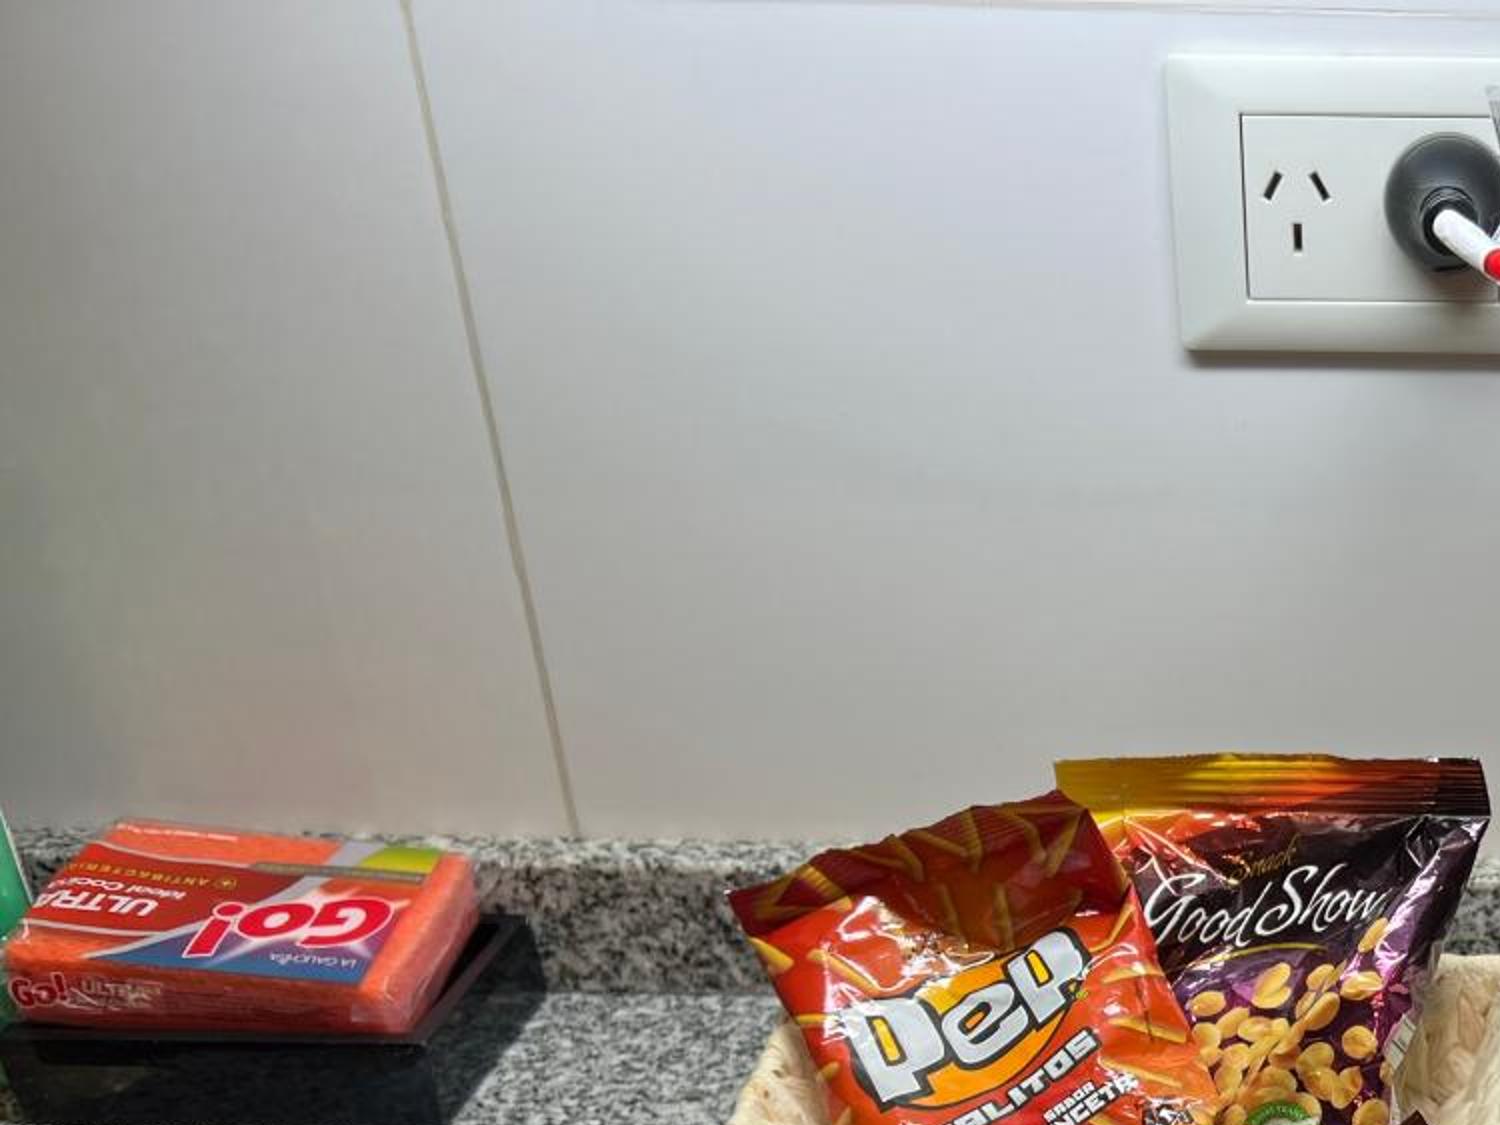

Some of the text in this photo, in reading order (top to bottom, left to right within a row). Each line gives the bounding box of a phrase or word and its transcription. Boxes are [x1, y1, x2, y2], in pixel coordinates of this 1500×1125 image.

[32, 889, 159, 917] ULTRA
[183, 895, 405, 960] GO!
[1142, 863, 1394, 947] Good Show
